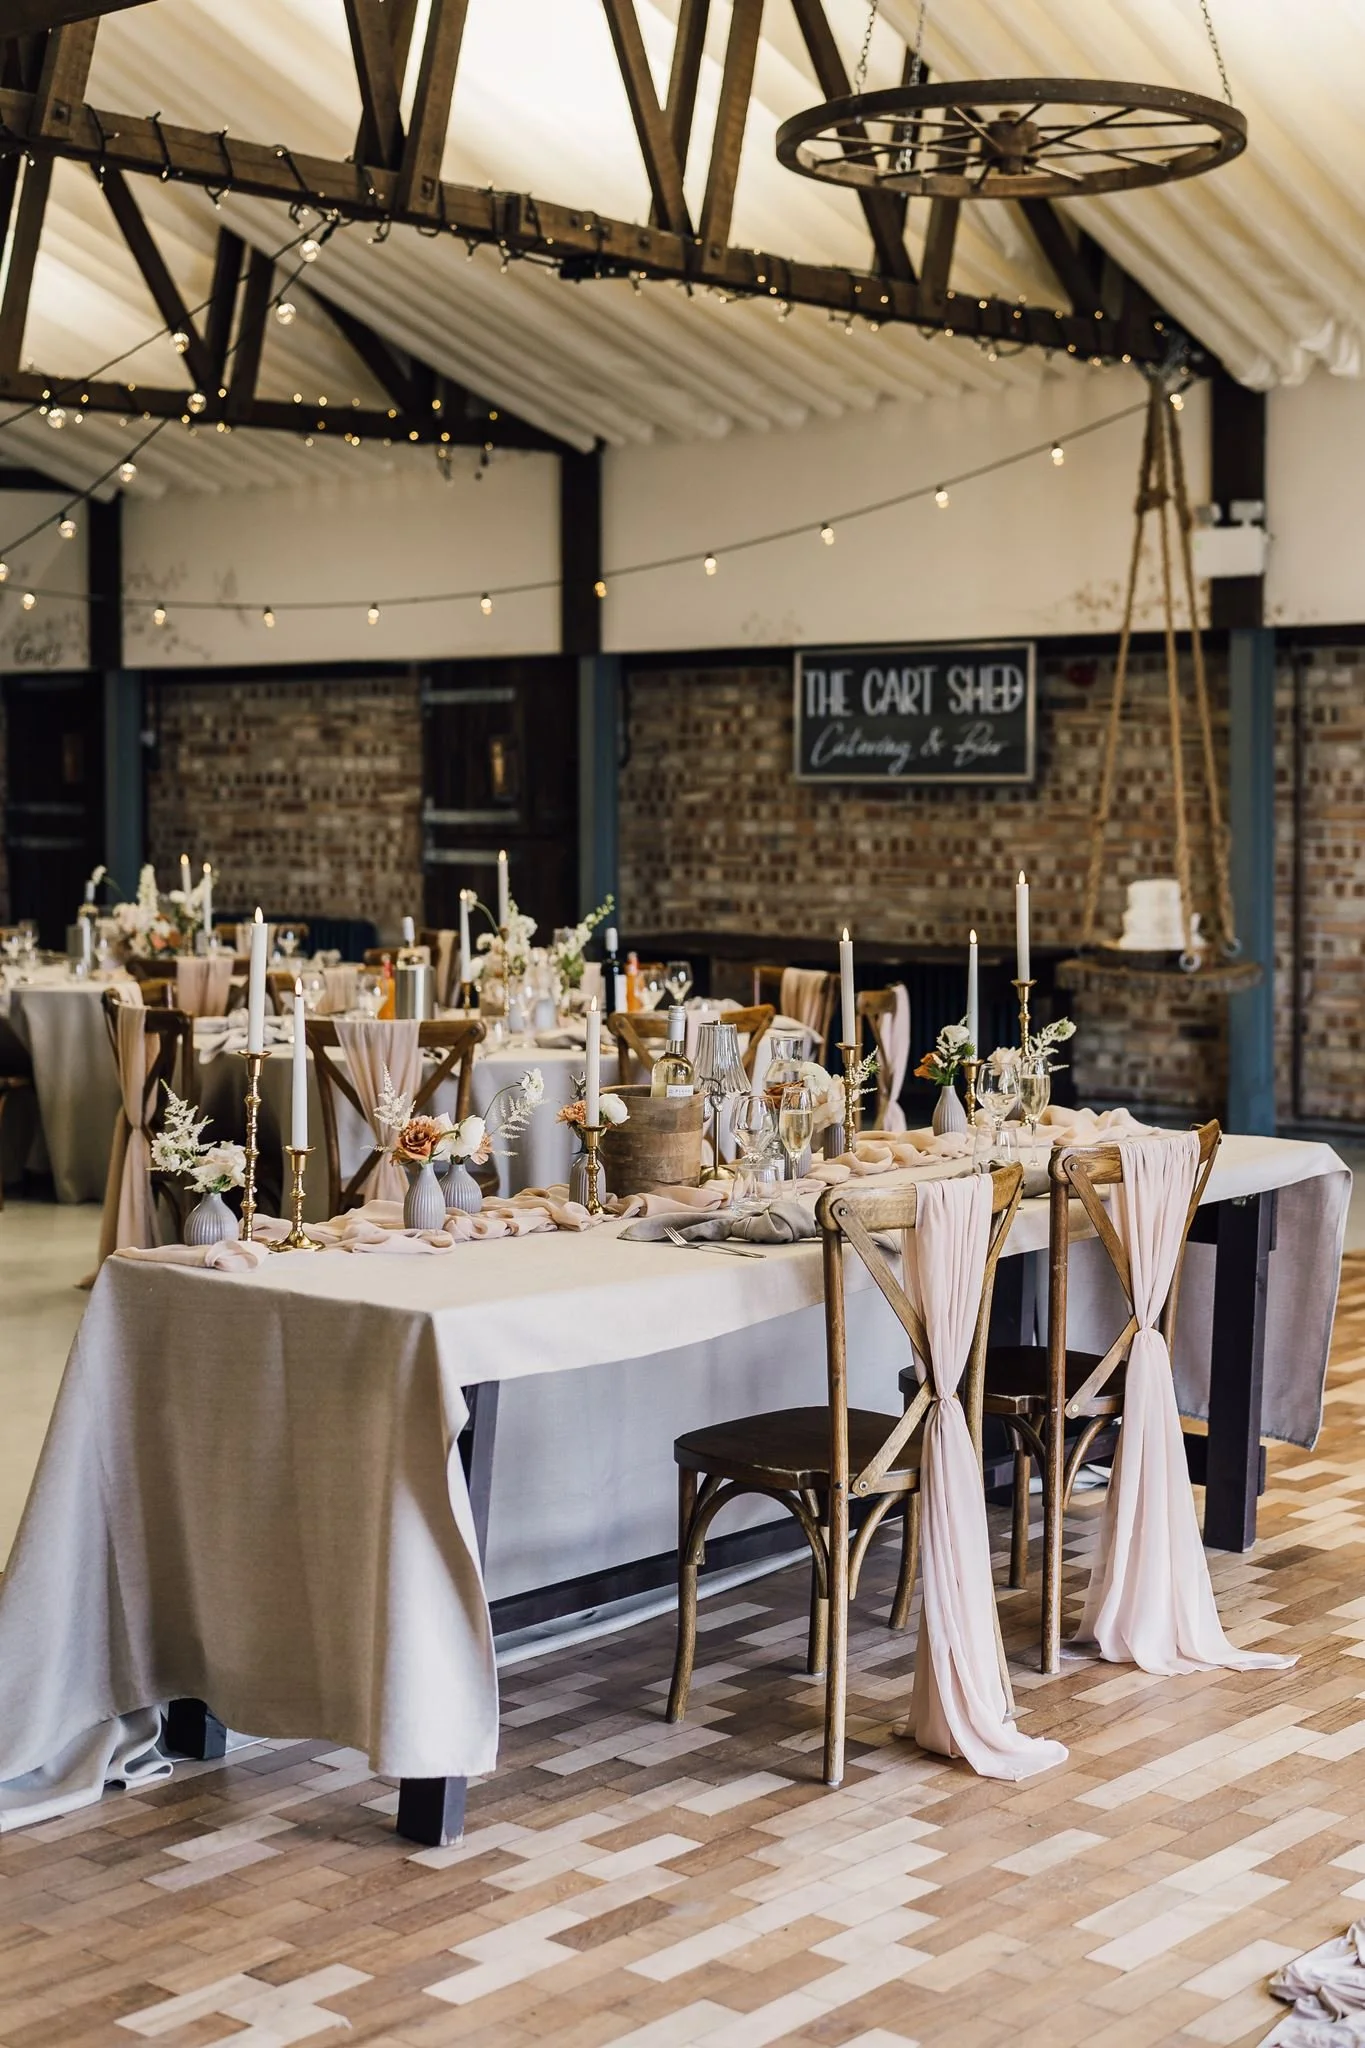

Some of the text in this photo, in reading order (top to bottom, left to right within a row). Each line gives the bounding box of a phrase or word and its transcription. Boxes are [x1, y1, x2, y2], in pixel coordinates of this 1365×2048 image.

[805, 664, 1025, 717] THE CART SHED
[920, 726, 946, 756] &
